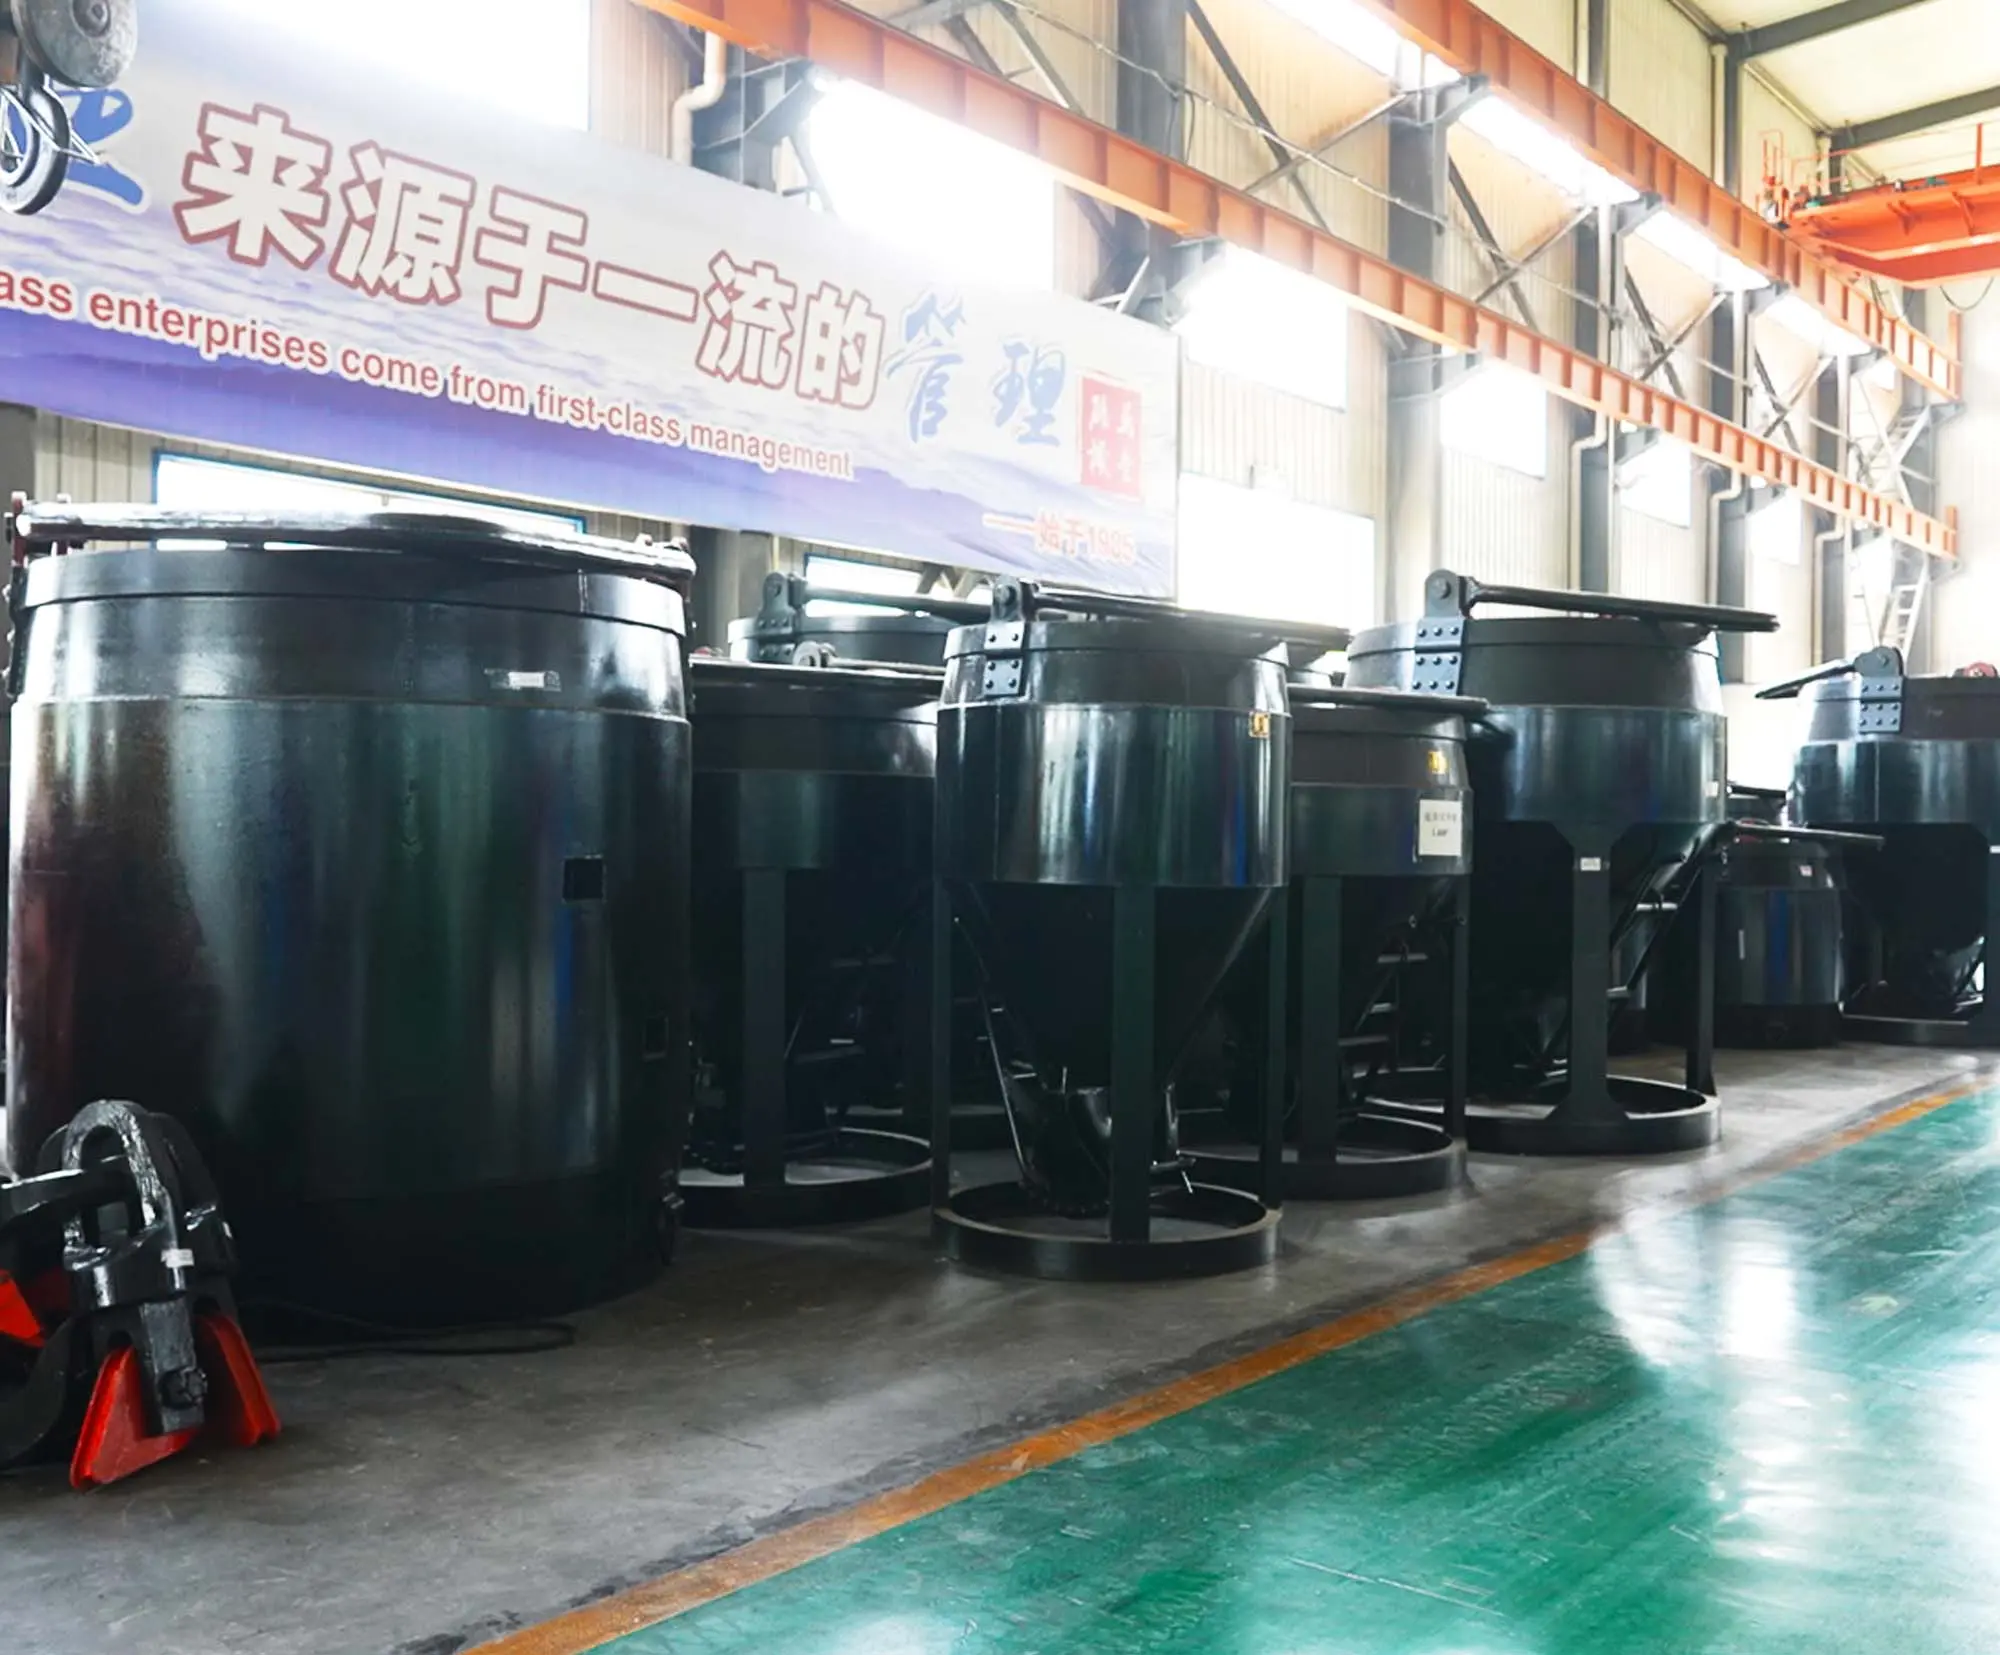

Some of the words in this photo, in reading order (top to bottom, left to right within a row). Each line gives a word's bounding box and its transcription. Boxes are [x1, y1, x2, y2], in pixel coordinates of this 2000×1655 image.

[0, 271, 72, 313] ass
[91, 291, 326, 367] enterprises
[342, 348, 438, 390] come
[452, 366, 525, 409] from
[538, 385, 681, 442] first-class
[691, 424, 851, 477] management
